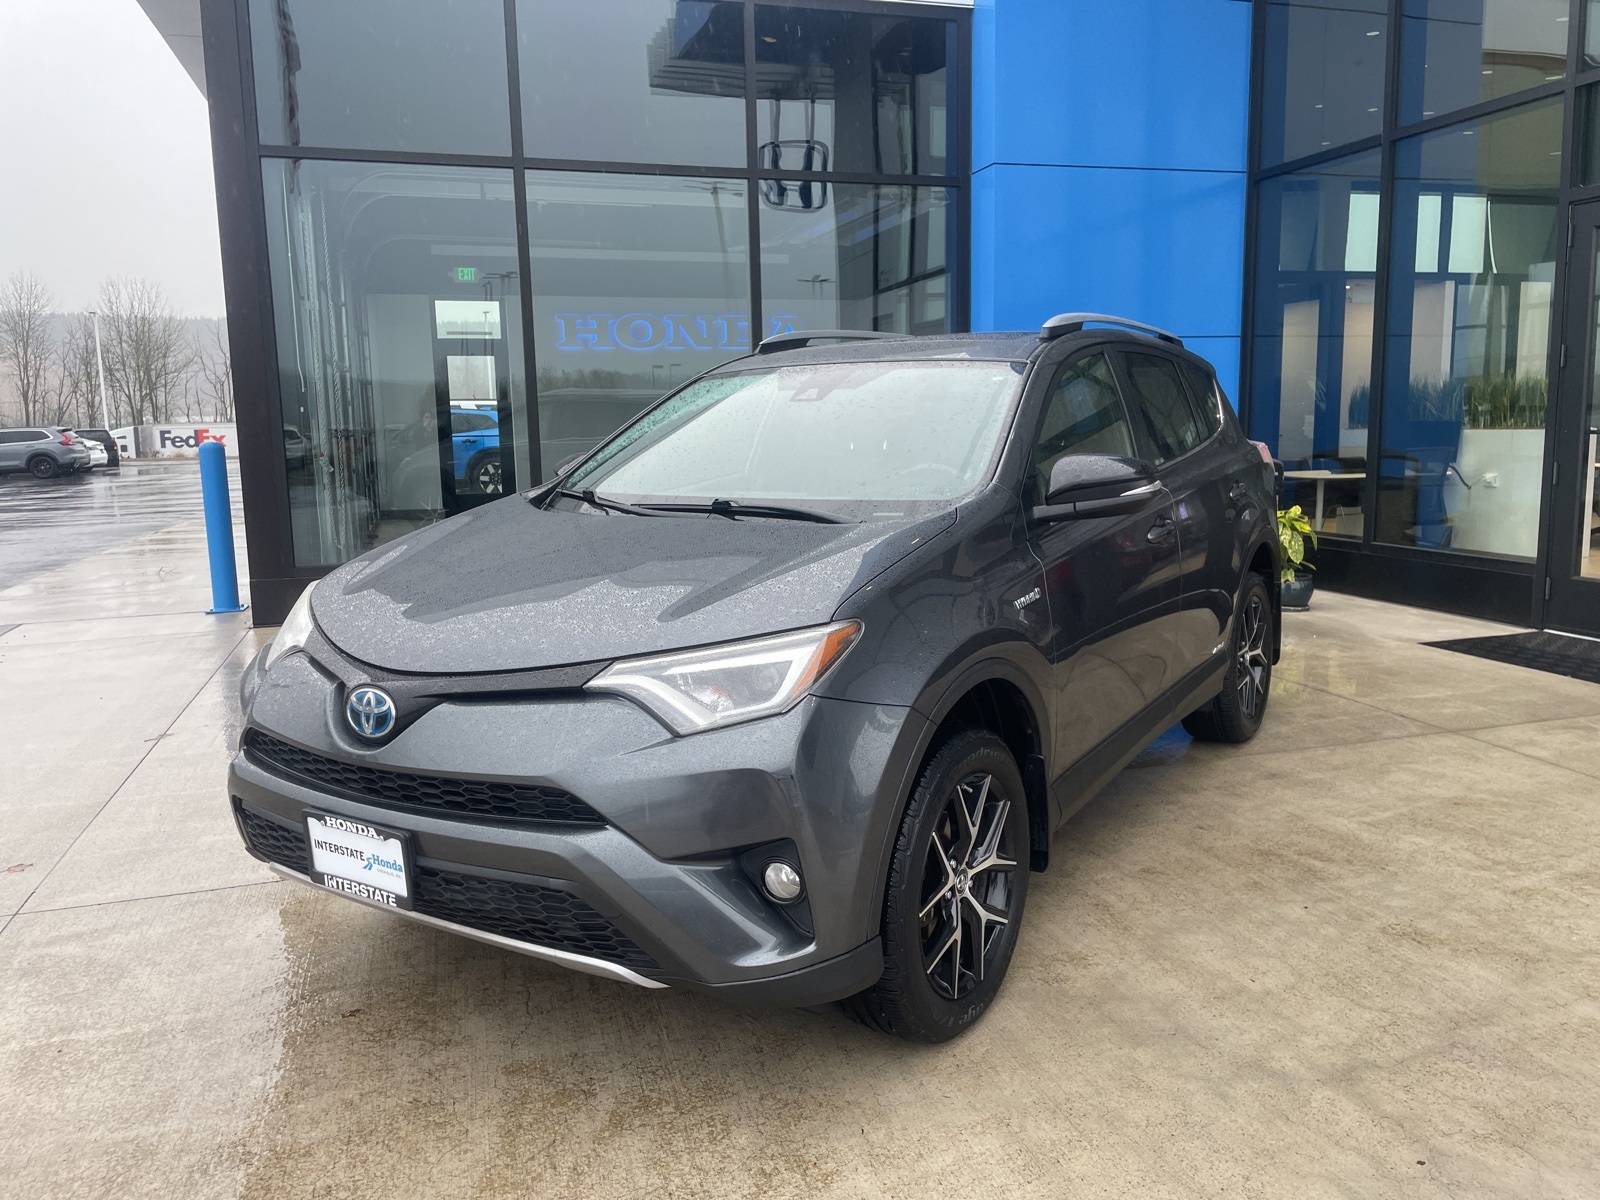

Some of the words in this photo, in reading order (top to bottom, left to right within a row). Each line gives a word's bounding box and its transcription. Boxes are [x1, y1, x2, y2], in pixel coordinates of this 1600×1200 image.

[458, 267, 475, 280] EXIT
[159, 429, 227, 449] FedEx
[324, 816, 379, 839] HONDA
[313, 839, 366, 862] INTERSTATE
[371, 854, 404, 873] Honda
[323, 874, 398, 907] INTERSTATE
